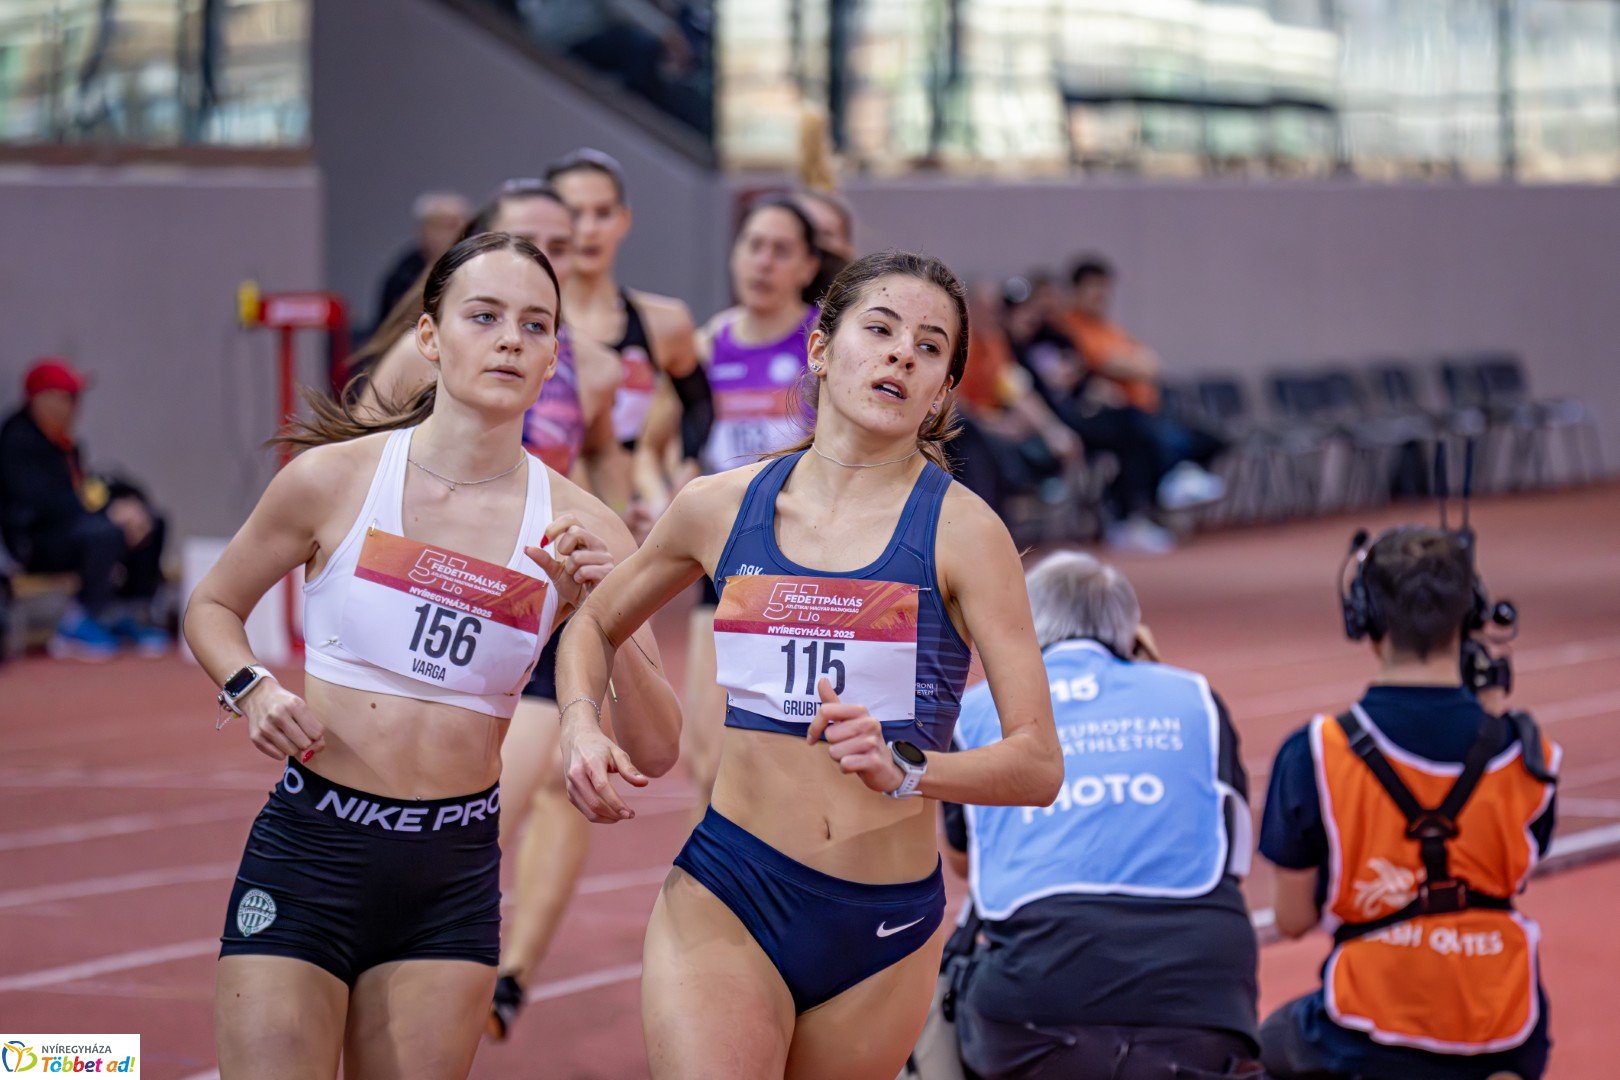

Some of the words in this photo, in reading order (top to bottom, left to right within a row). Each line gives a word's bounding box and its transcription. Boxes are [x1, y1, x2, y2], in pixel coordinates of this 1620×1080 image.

[431, 562, 508, 592] FEDETTPÁLYÁS
[409, 586, 470, 611] NYÍREGYHÁZA
[470, 606, 493, 618] 2025
[785, 594, 863, 608] FEDETTPÁLYÁS
[408, 602, 482, 667] 156
[768, 624, 832, 638] NYÍREGYHÁZA
[833, 629, 856, 639] 2025
[412, 658, 447, 681] VARGA
[781, 639, 846, 696] 115
[1063, 734, 1184, 756] ATHLETICS
[316, 790, 429, 832] NIKE
